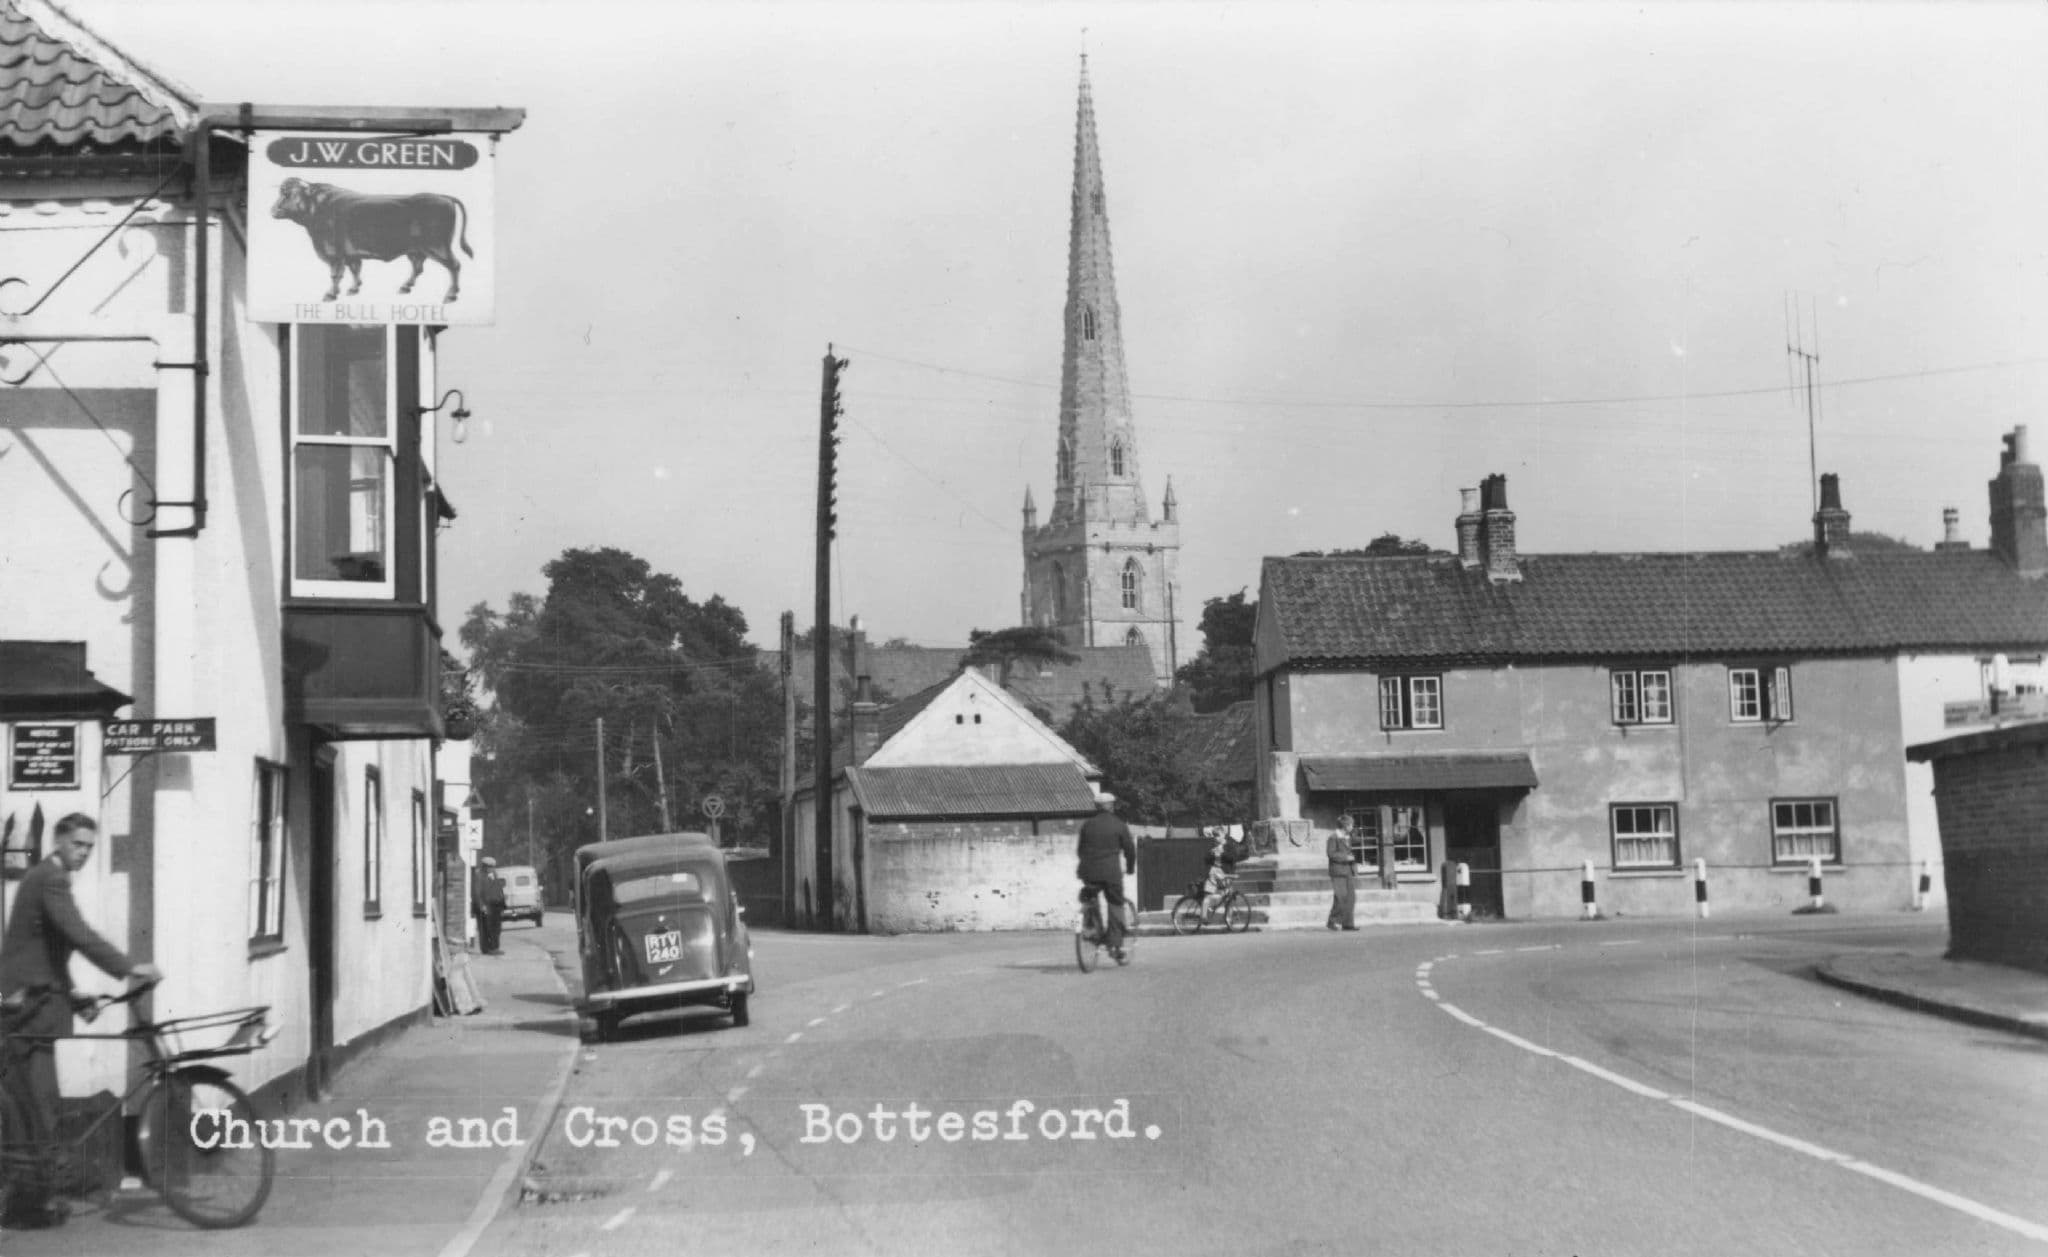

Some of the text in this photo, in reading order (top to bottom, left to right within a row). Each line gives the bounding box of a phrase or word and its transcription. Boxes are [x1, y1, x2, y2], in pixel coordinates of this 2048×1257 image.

[295, 303, 448, 321] THE BULL HOTEL
[106, 723, 197, 736] CAR PARK
[163, 735, 202, 747] ONLY
[650, 932, 678, 949] RTV
[651, 945, 680, 961] 240
